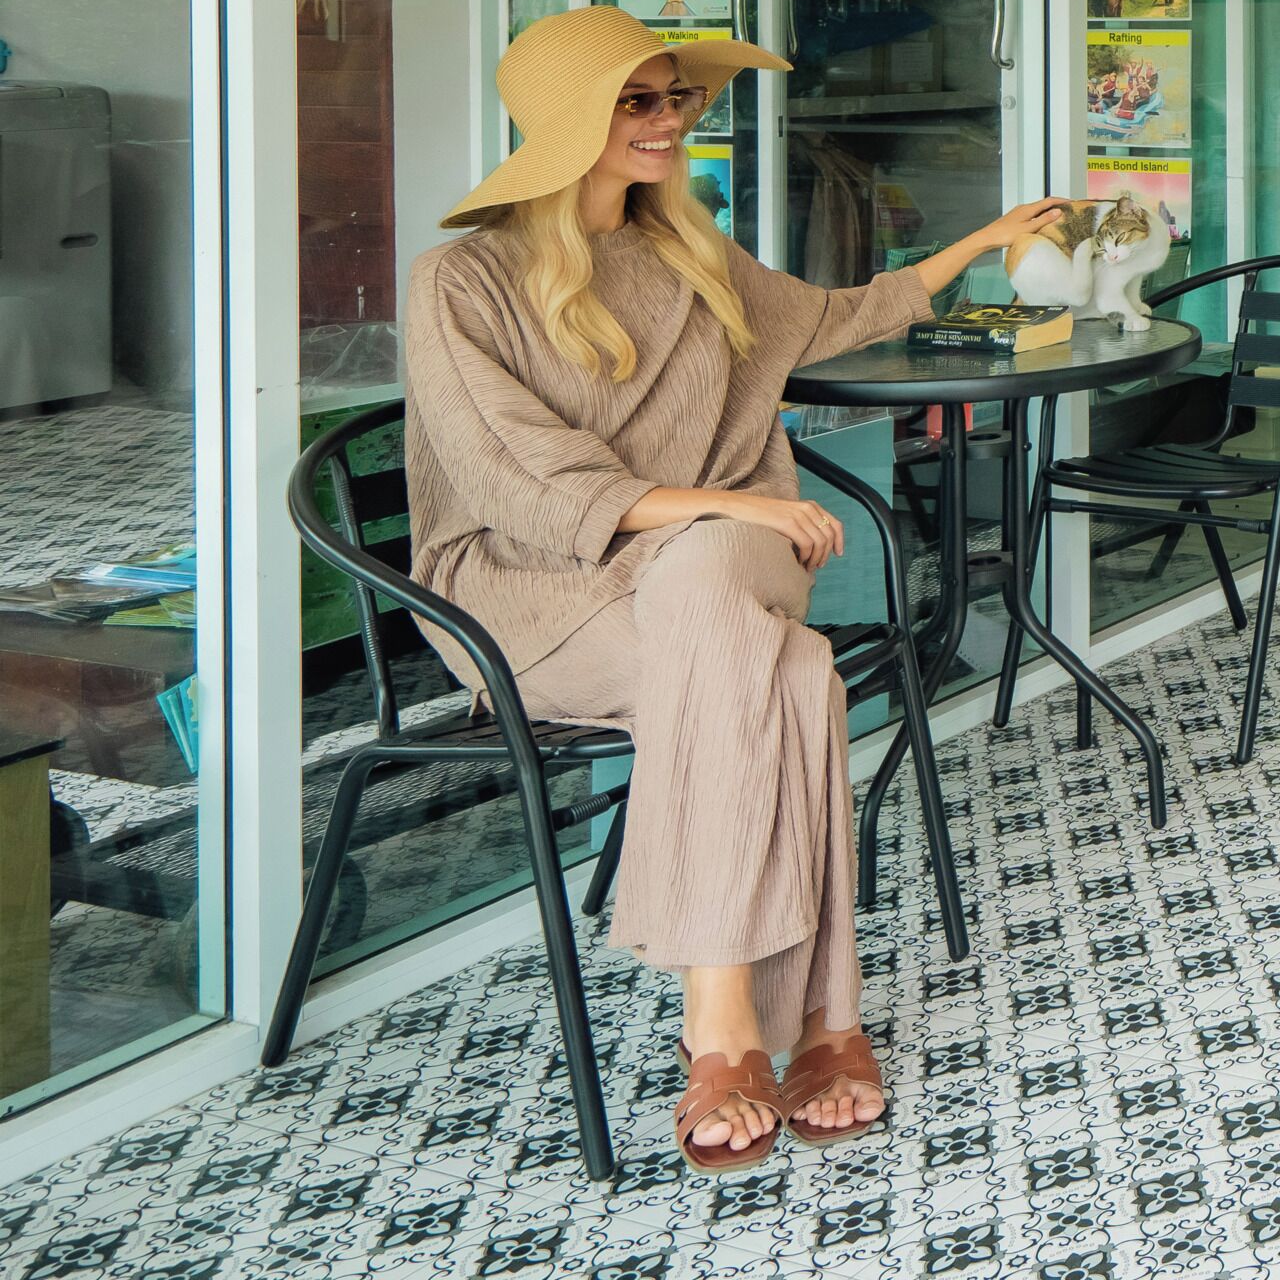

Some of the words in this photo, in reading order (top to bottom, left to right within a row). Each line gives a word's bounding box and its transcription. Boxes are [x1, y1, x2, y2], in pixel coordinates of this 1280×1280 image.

[1108, 33, 1143, 44] Rafting
[1087, 162, 1111, 170] ames
[1113, 161, 1138, 171] Bond
[1140, 161, 1169, 172] Island
